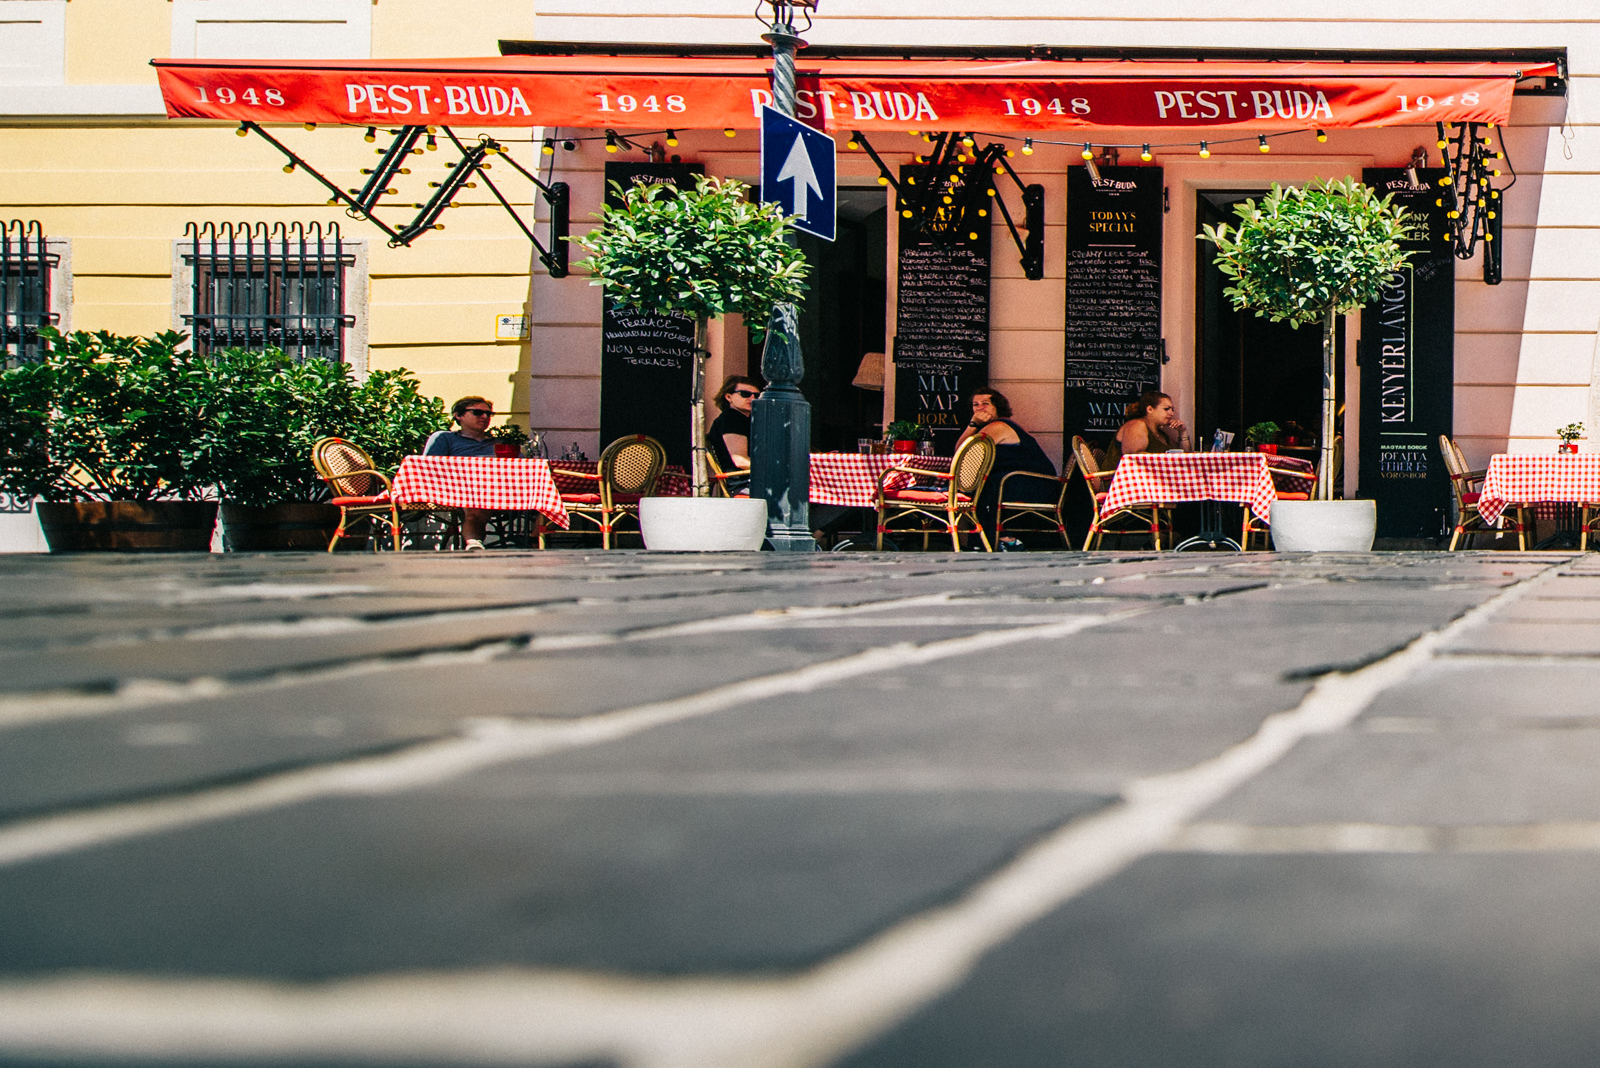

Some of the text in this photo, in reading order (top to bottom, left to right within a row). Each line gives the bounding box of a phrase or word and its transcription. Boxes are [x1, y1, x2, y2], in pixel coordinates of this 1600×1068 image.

[194, 86, 285, 106] 1948
[596, 94, 687, 113] 1948
[1396, 92, 1480, 112] 1948
[750, 88, 939, 121] PST·BUDA
[1001, 97, 1091, 116] 1948
[1089, 211, 1136, 220] TODAY'S
[1089, 222, 1136, 232] SPECIAL
[652, 331, 694, 344] KITCHEN
[607, 344, 691, 357] NON SMOKING
[918, 375, 959, 391] MAI
[1086, 381, 1133, 389] SMOKING
[918, 394, 959, 410] NAP
[917, 412, 959, 425] BORA
